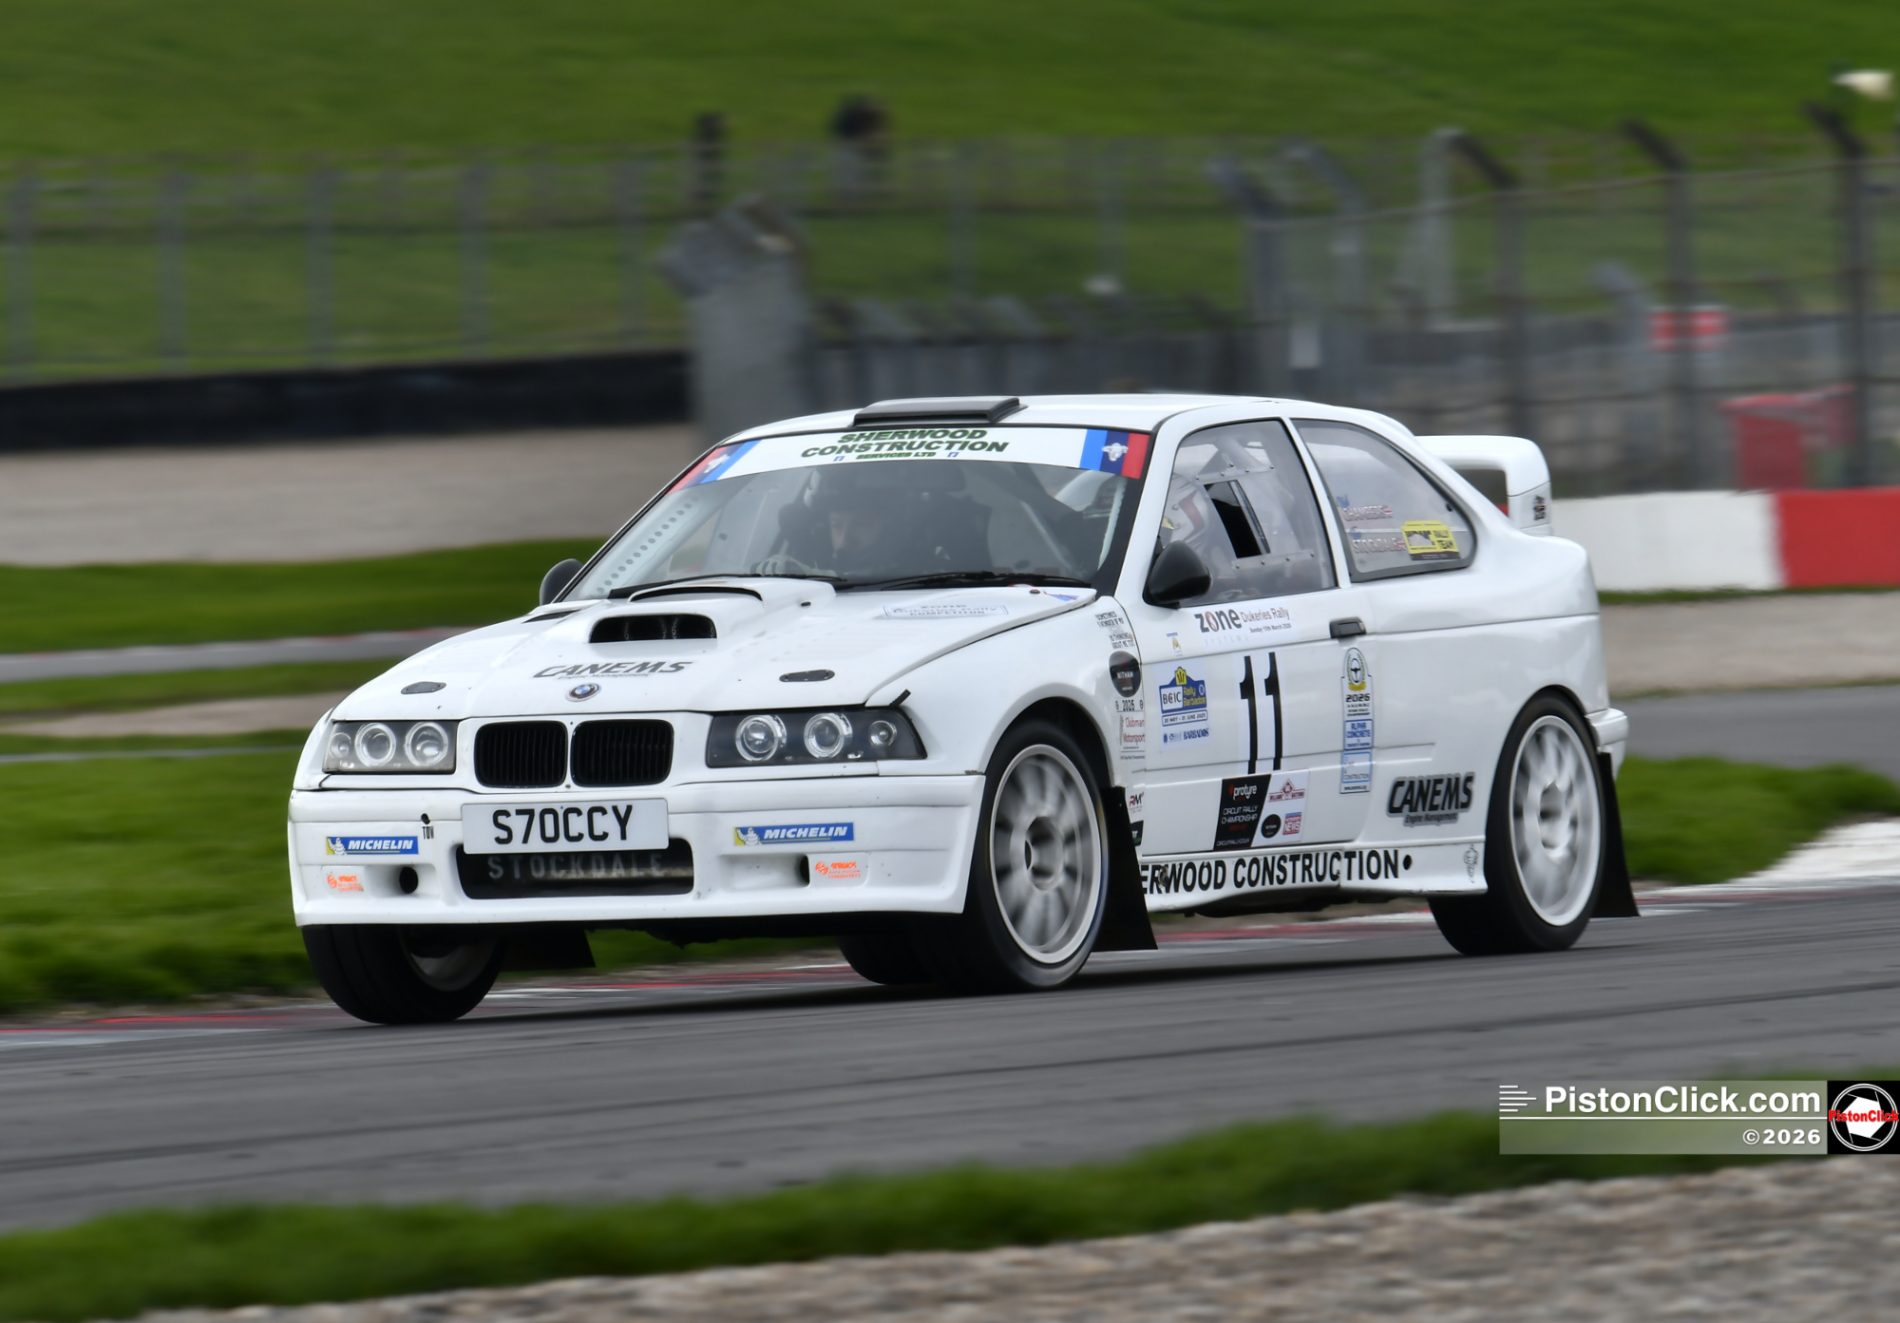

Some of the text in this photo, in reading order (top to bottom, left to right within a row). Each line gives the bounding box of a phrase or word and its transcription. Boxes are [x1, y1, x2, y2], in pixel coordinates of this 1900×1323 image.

[838, 429, 988, 443] SHERWOOD
[801, 440, 1009, 458] CONSTRUCTION
[1194, 609, 1242, 633] zone
[532, 661, 694, 678] CANEMS
[1240, 652, 1282, 774] 11
[1388, 776, 1475, 813] CANEMS
[492, 804, 633, 845] S70CCY
[763, 826, 848, 840] MICHELIN
[348, 839, 414, 850] MICHELIN
[488, 854, 665, 880] STOCKDALE
[1234, 849, 1400, 889] CONSTRUCTION
